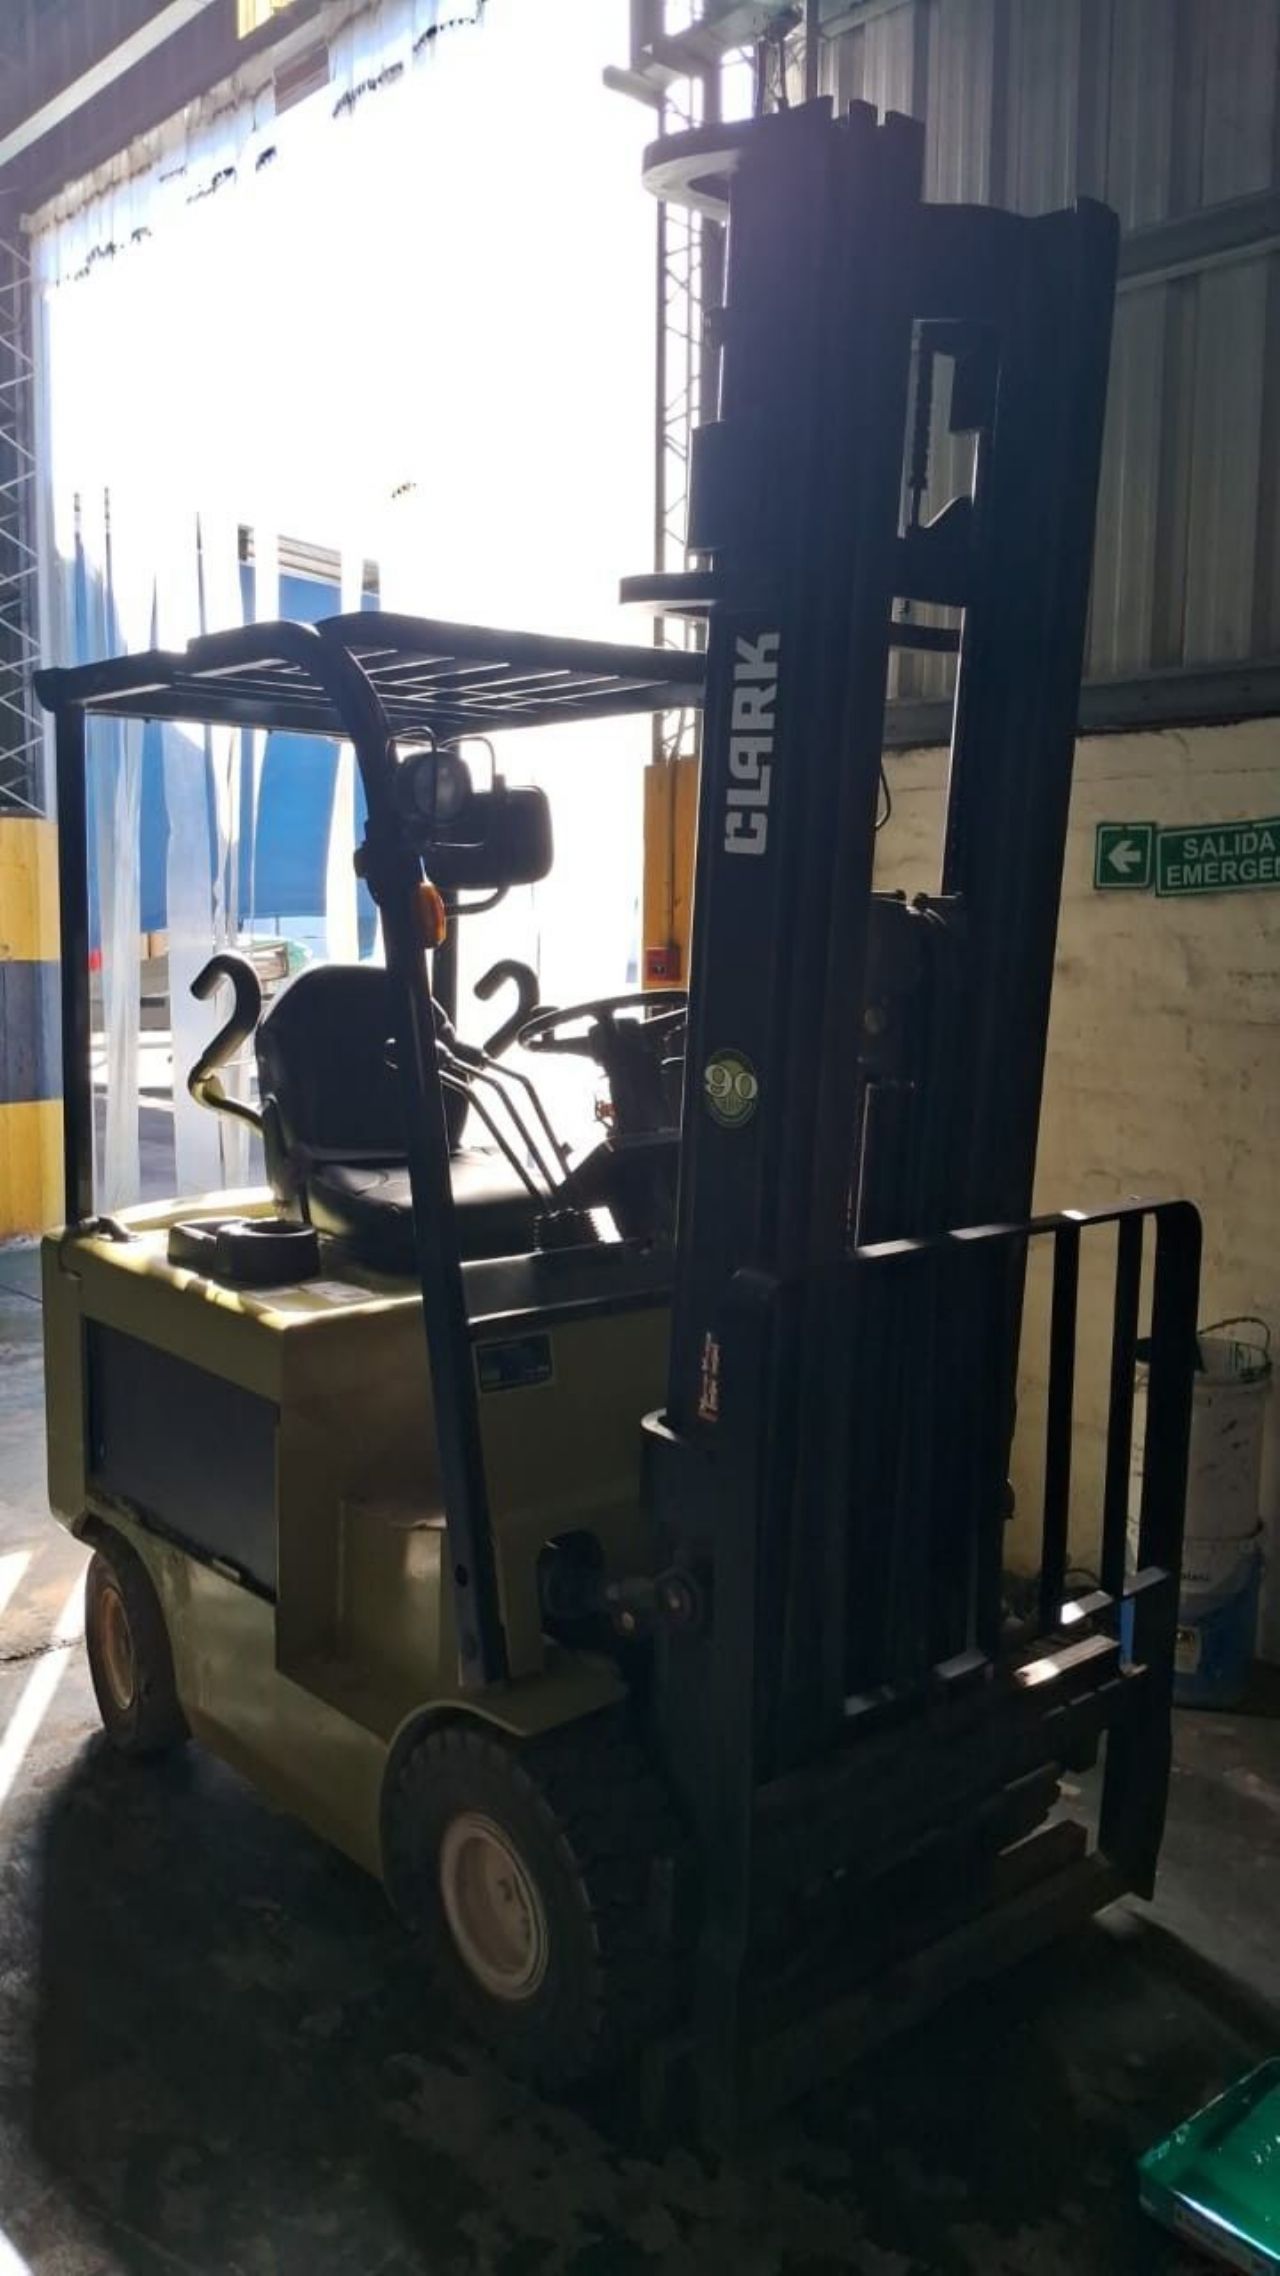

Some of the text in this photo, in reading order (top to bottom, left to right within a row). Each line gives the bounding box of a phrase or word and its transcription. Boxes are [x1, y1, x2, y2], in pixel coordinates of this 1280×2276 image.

[724, 632, 781, 855] CLARK
[1183, 830, 1277, 859] SALIDA
[704, 1064, 759, 1100] 90
